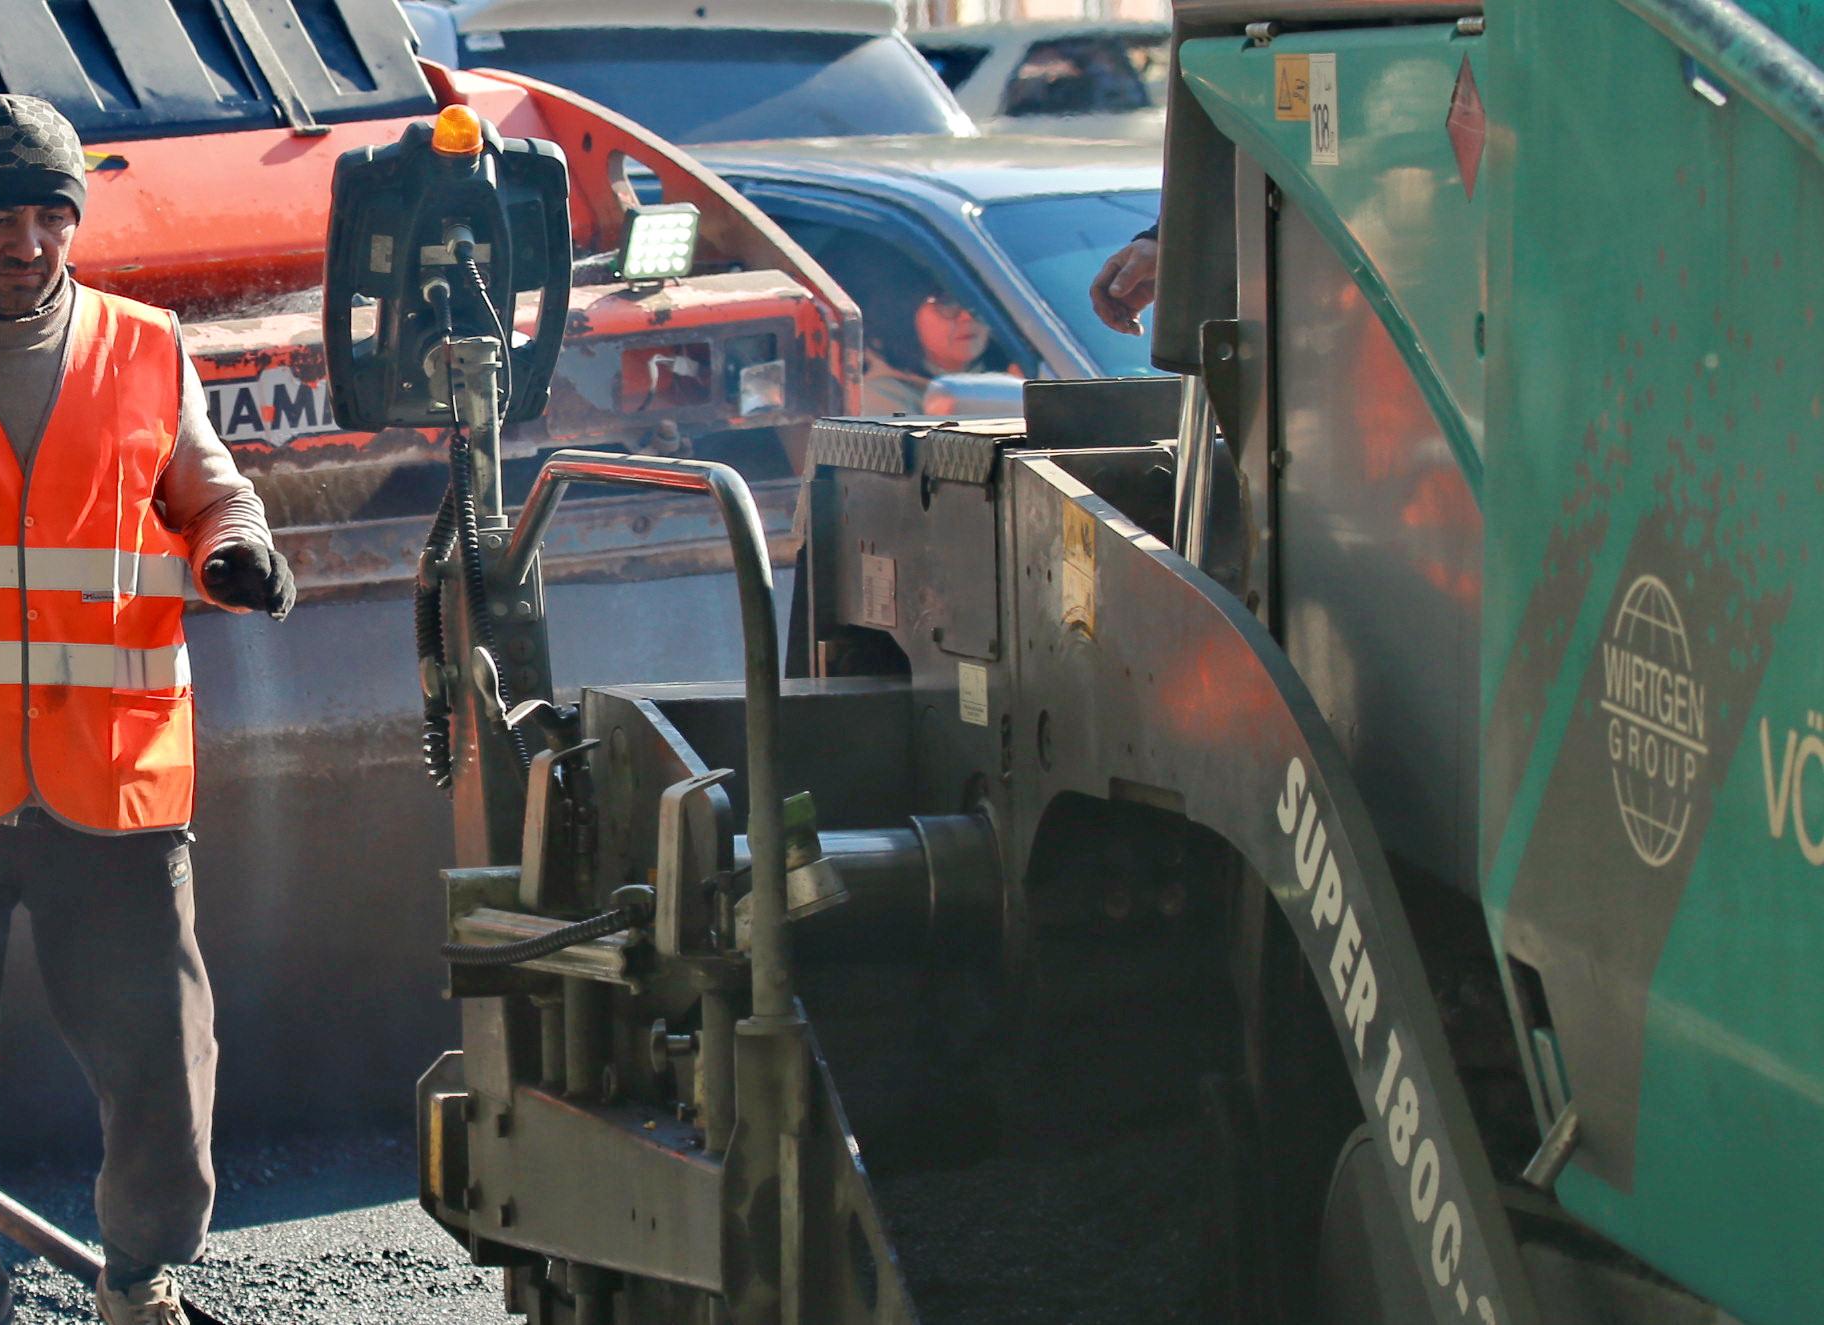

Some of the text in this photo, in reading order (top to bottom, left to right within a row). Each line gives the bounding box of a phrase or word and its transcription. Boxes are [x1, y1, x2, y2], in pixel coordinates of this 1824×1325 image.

[1603, 641, 1706, 740] WIRTGEN
[1608, 717, 1697, 795] GROUP
[1277, 756, 1379, 1060] SUPER
